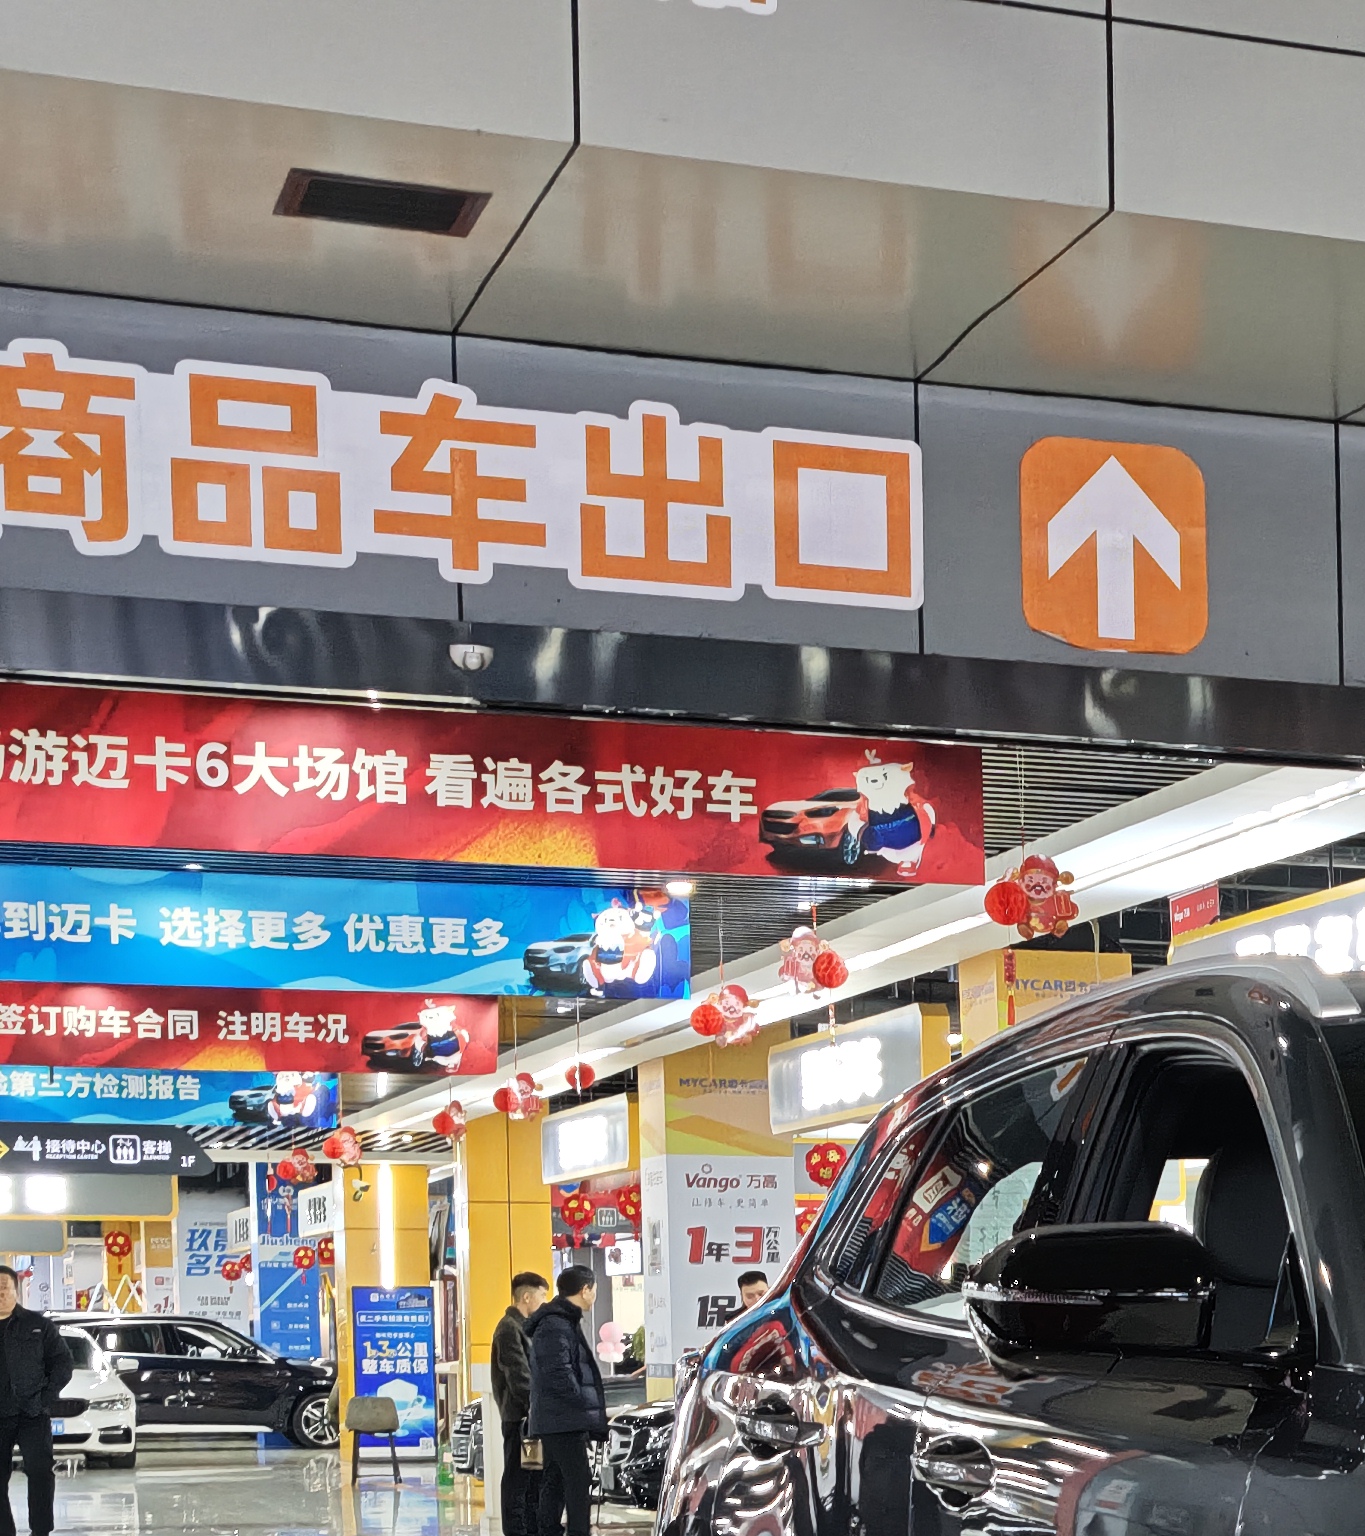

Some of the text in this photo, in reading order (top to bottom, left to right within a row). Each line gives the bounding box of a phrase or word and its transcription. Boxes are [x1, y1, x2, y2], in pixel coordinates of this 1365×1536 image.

[0, 352, 913, 598] 商品车出口
[0, 728, 757, 823] 游迈卡6大场馆 看遍各式好车
[0, 901, 511, 957] 到迈卡 选择更多 优惠更多
[216, 1012, 350, 1044] 注明车况
[46, 1138, 172, 1154] 接待中心 客梯
[180, 1155, 196, 1167] 1F
[685, 1172, 741, 1193] Vango
[746, 1174, 777, 1189] 万高
